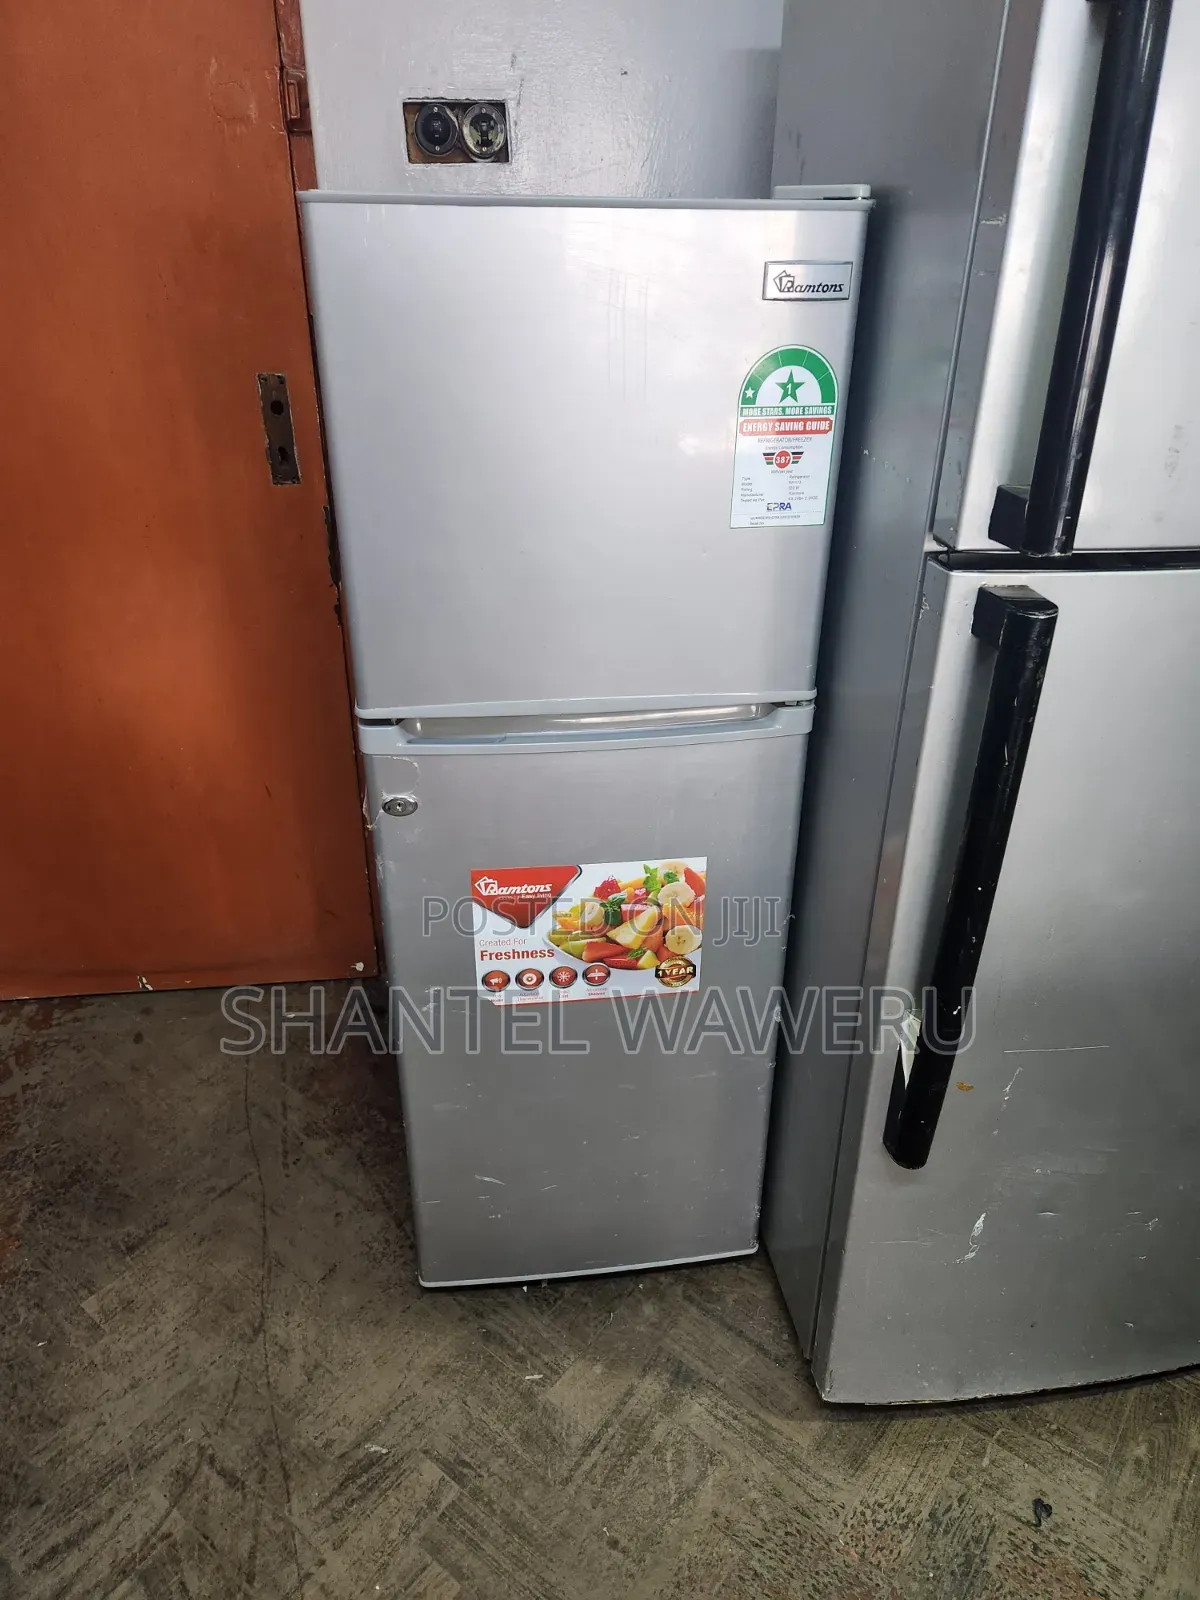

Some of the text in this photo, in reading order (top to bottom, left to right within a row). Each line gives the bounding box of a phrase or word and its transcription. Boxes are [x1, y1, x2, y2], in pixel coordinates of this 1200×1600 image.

[778, 276, 844, 294] Ramtons
[786, 383, 792, 395] 1
[742, 407, 763, 416] MORE
[785, 406, 803, 415] MORE
[804, 405, 832, 415] SAVINGS
[742, 420, 830, 433] ENERGY SAVING GUIDE
[775, 456, 790, 464] 387
[766, 502, 792, 511] EPRA
[483, 879, 553, 896] Ramtons
[479, 938, 526, 947] Created For
[480, 948, 555, 961] Freshness
[665, 966, 694, 976] YEAR
